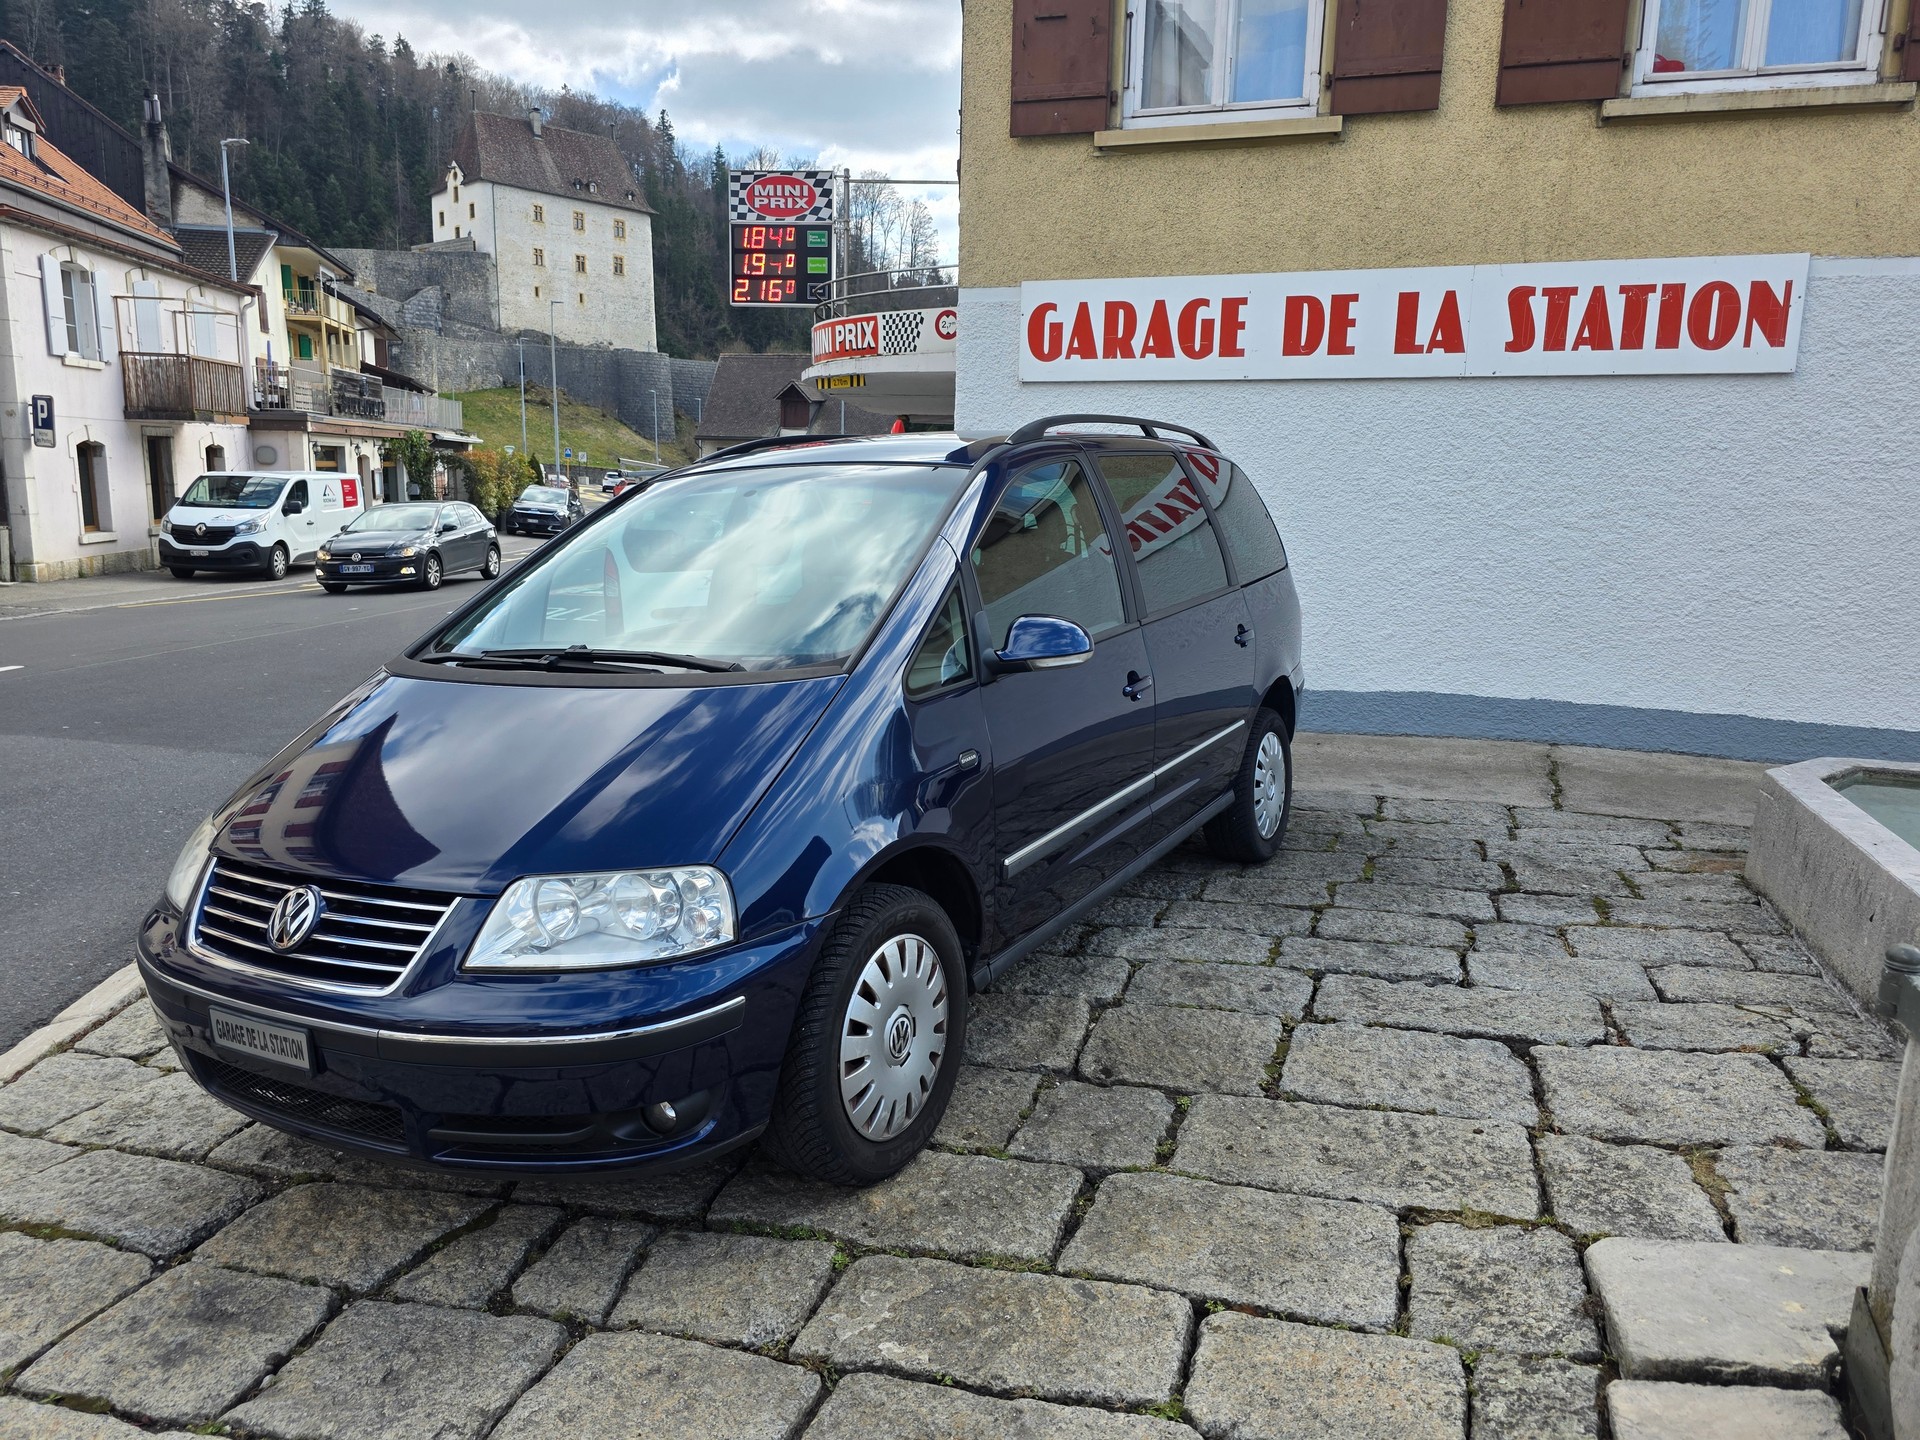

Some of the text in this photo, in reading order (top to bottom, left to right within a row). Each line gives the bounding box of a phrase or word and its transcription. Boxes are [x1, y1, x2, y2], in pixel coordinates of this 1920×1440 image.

[753, 197, 809, 209] PRIX
[754, 184, 809, 197] MINI
[1027, 279, 1793, 362] GARAGE DE LA STATION
[835, 321, 876, 352] PRIX
[37, 400, 48, 427] P
[216, 1018, 305, 1061] GARAGE DE LA STATION
